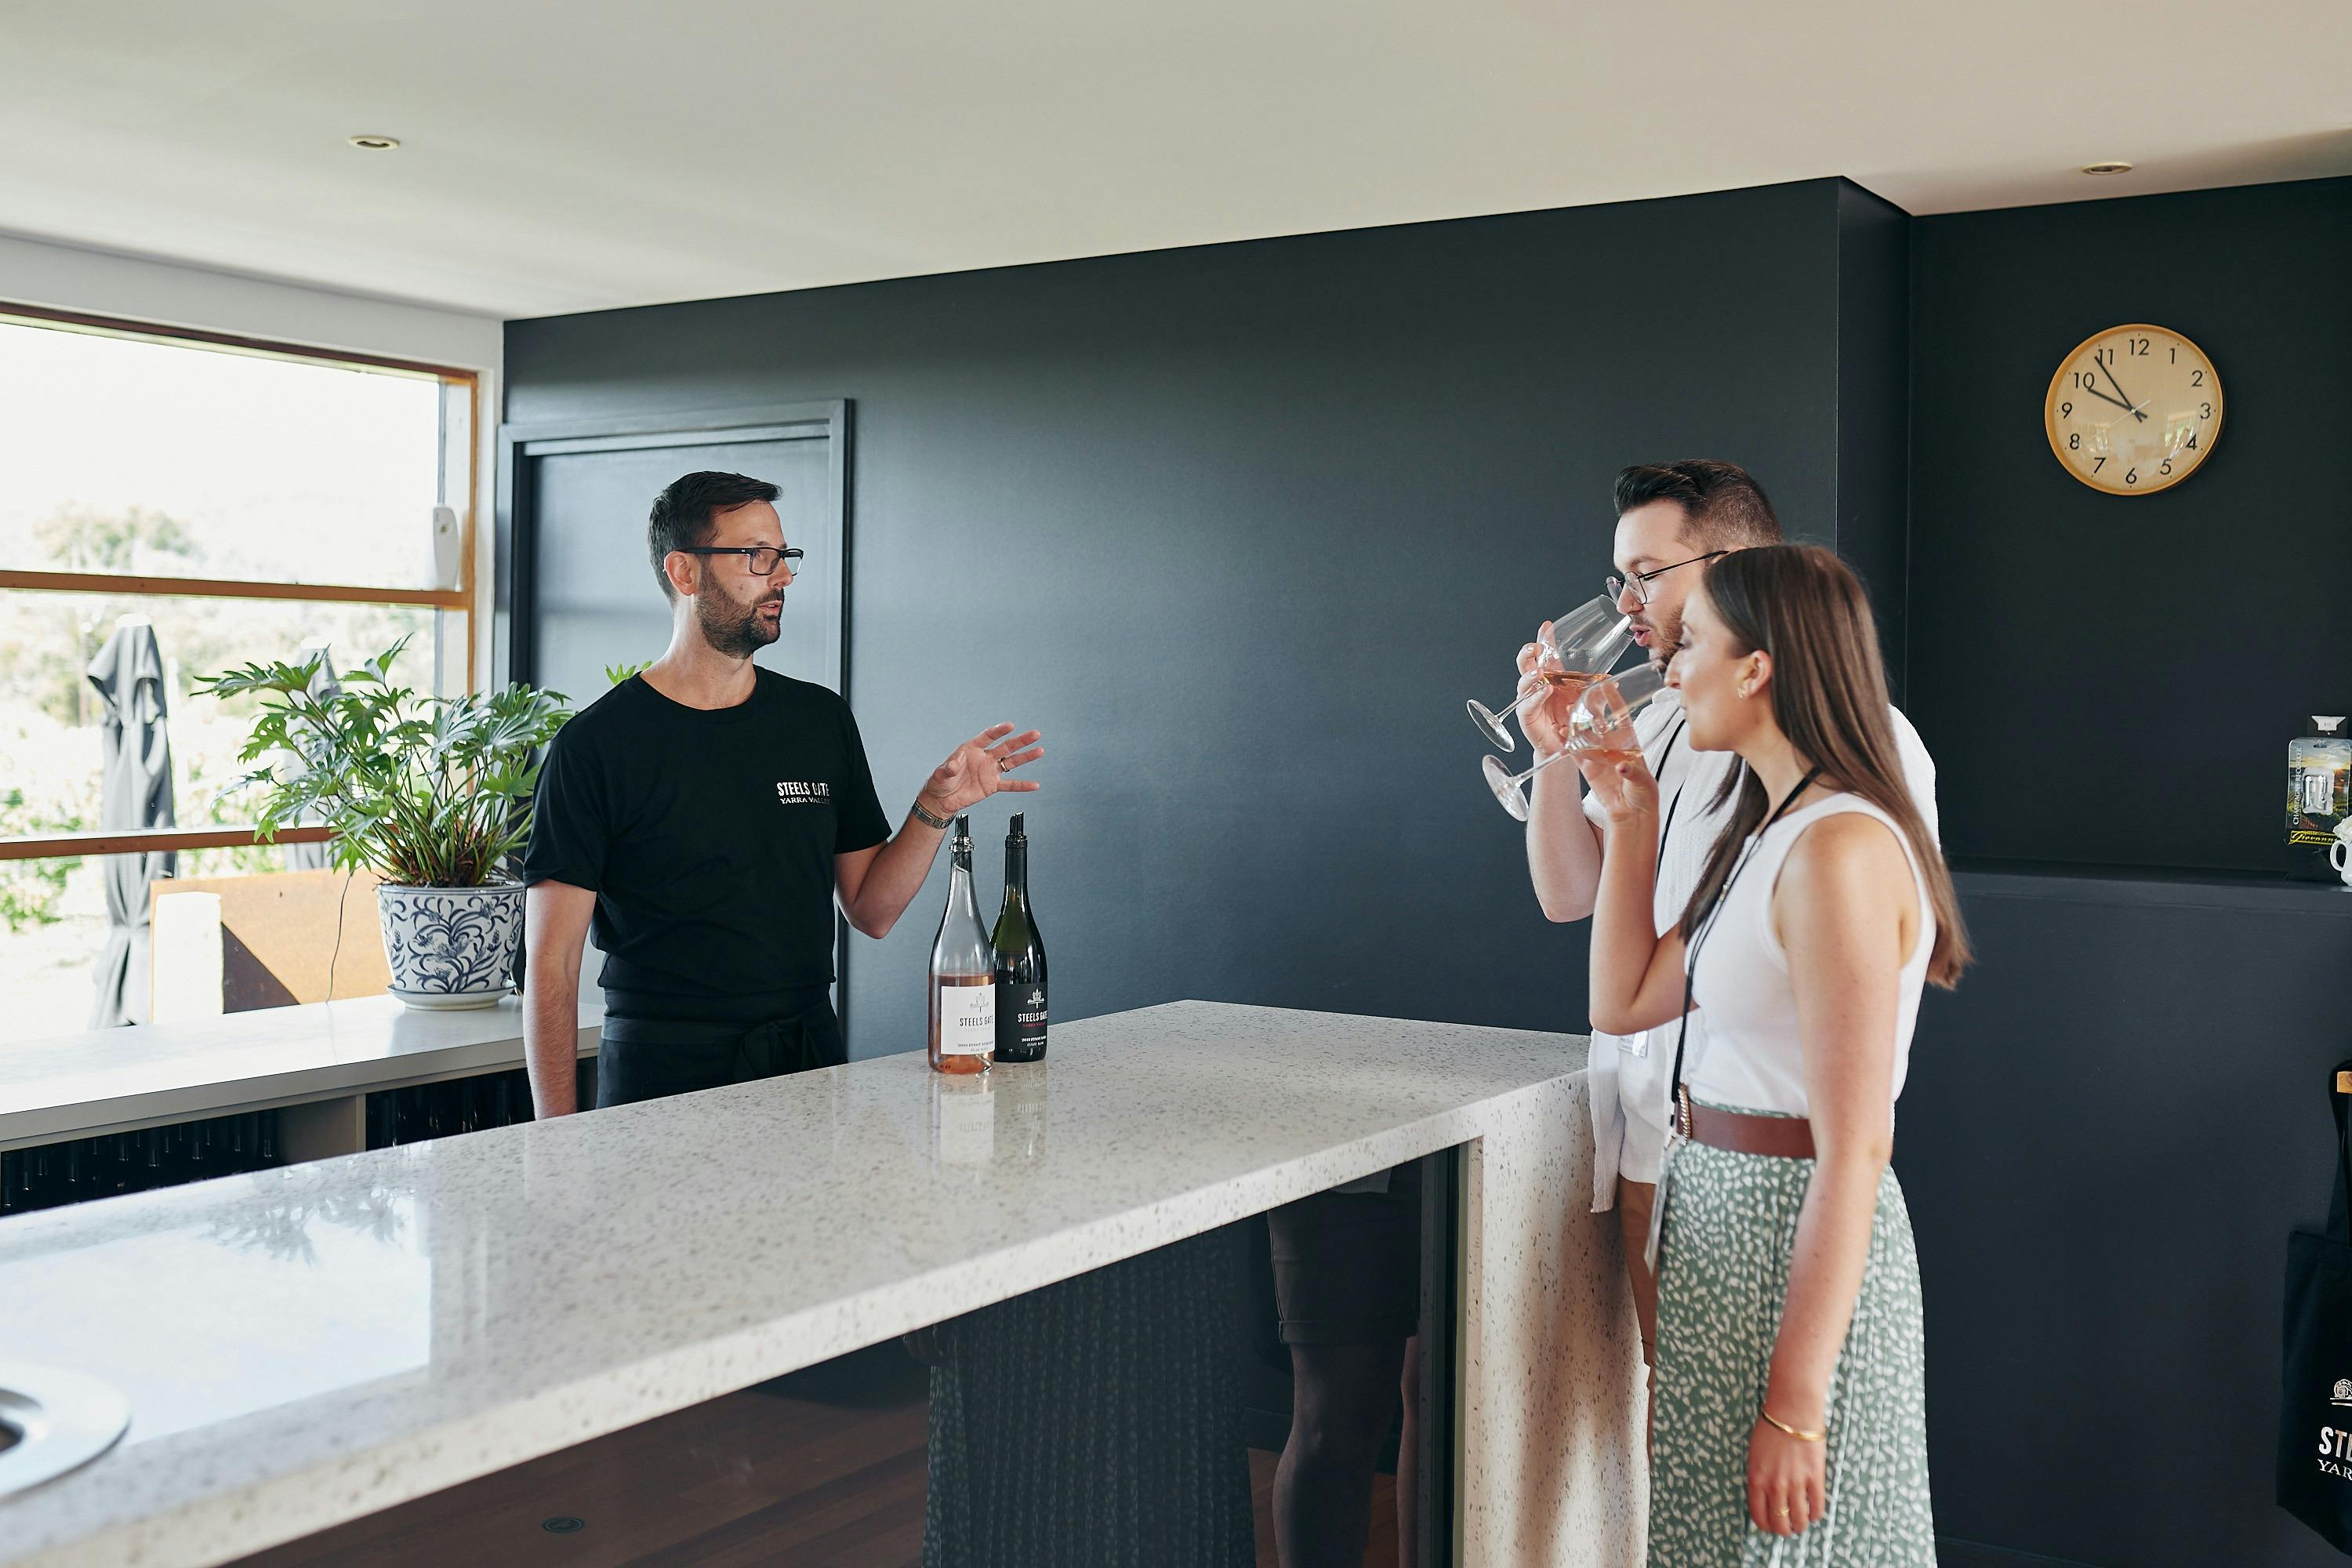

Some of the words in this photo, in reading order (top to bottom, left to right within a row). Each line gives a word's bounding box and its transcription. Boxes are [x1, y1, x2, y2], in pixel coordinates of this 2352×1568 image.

[2129, 339, 2150, 355] 12
[2098, 349, 2114, 365] 11
[2170, 347, 2176, 365] 1
[2074, 372, 2095, 389] 10
[2191, 370, 2203, 387] 2
[2061, 402, 2073, 419] 9
[2199, 402, 2211, 419] 3
[2069, 433, 2081, 449] 8
[2186, 434, 2198, 450] 4
[2094, 457, 2107, 474] 7
[2160, 459, 2172, 475] 5
[2125, 467, 2137, 484] 6
[776, 782, 811, 797] STEELS
[2292, 782, 2302, 826] CHAMPAGNE
[960, 1016, 983, 1027] STEELS
[1018, 1012, 1040, 1022] STEELS
